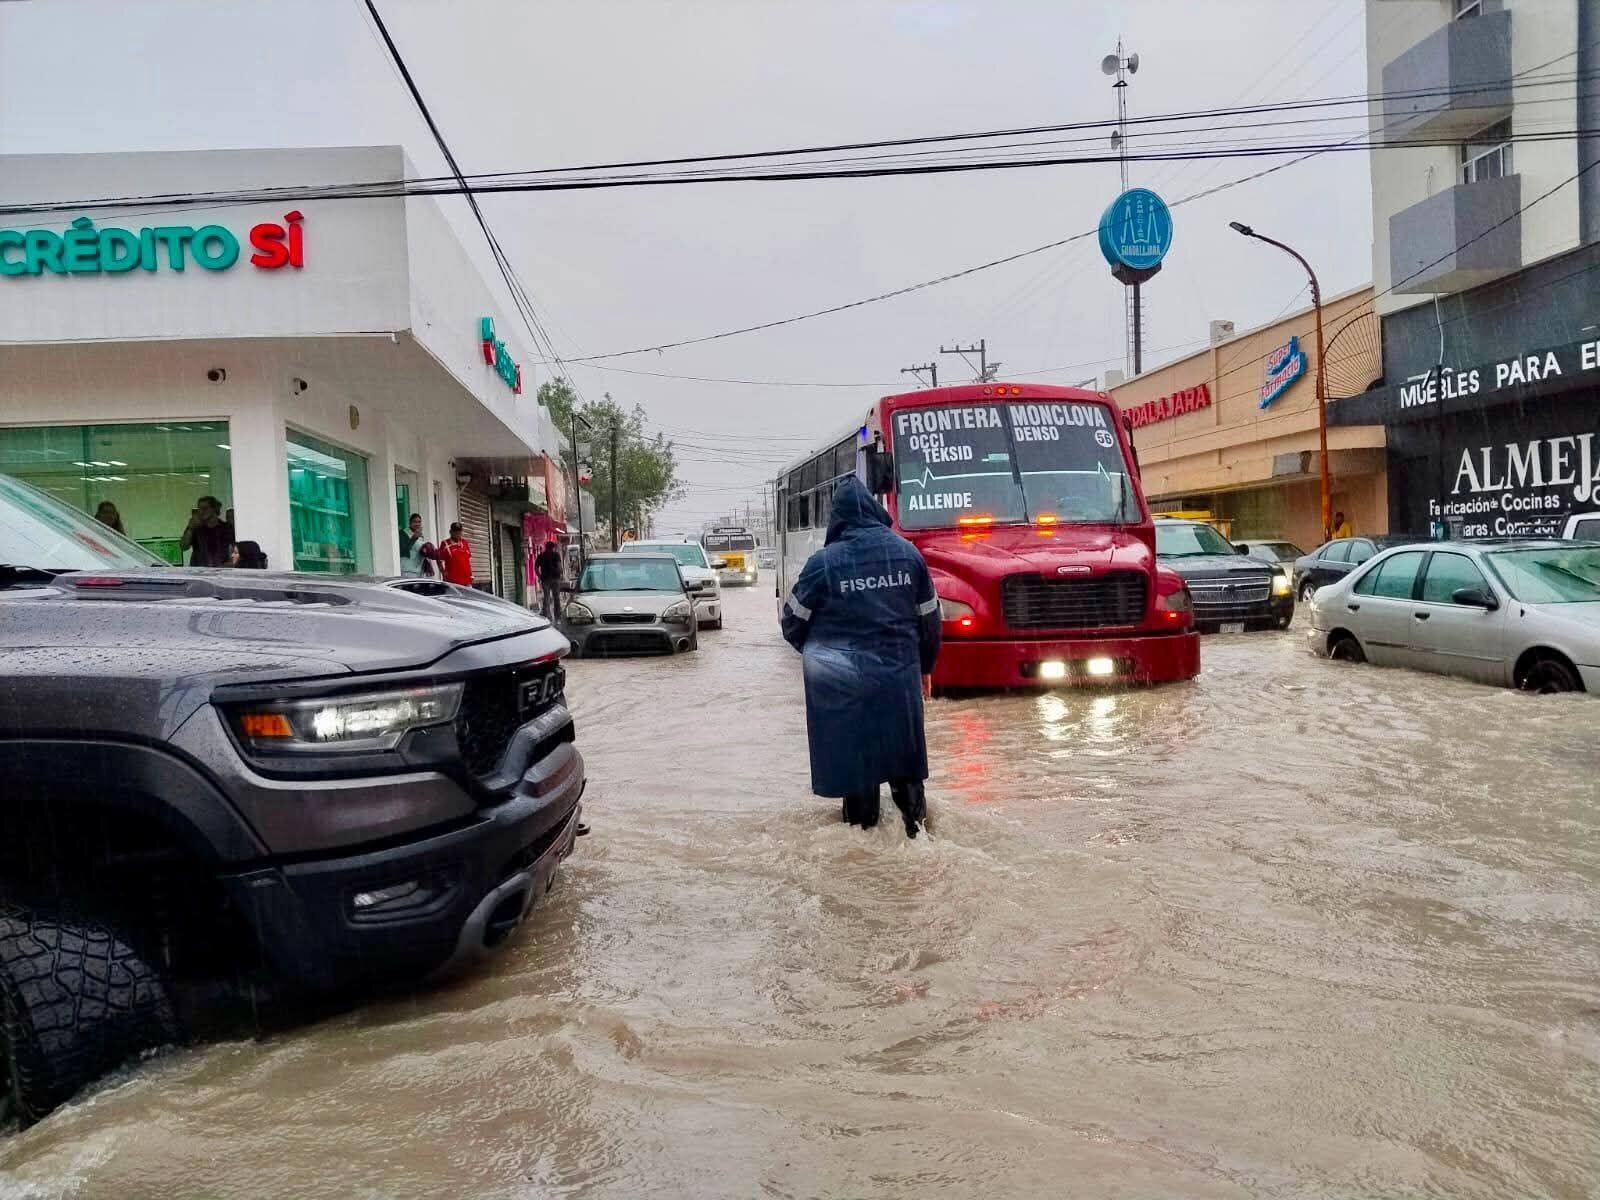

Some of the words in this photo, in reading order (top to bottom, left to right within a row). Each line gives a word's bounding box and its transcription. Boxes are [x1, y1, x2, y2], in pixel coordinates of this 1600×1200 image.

[0, 216, 240, 276] CRÉDITO
[250, 210, 305, 269] SÍ
[1496, 350, 1563, 388] PARA
[898, 407, 1002, 436] FRONTERA
[1009, 404, 1107, 428] MONCLOVA
[909, 433, 945, 451] OCCI
[1014, 426, 1060, 442] DENSO
[923, 446, 973, 464] TEKSID
[908, 492, 973, 511] ALLENDE
[840, 570, 912, 593] FISCALÍA
